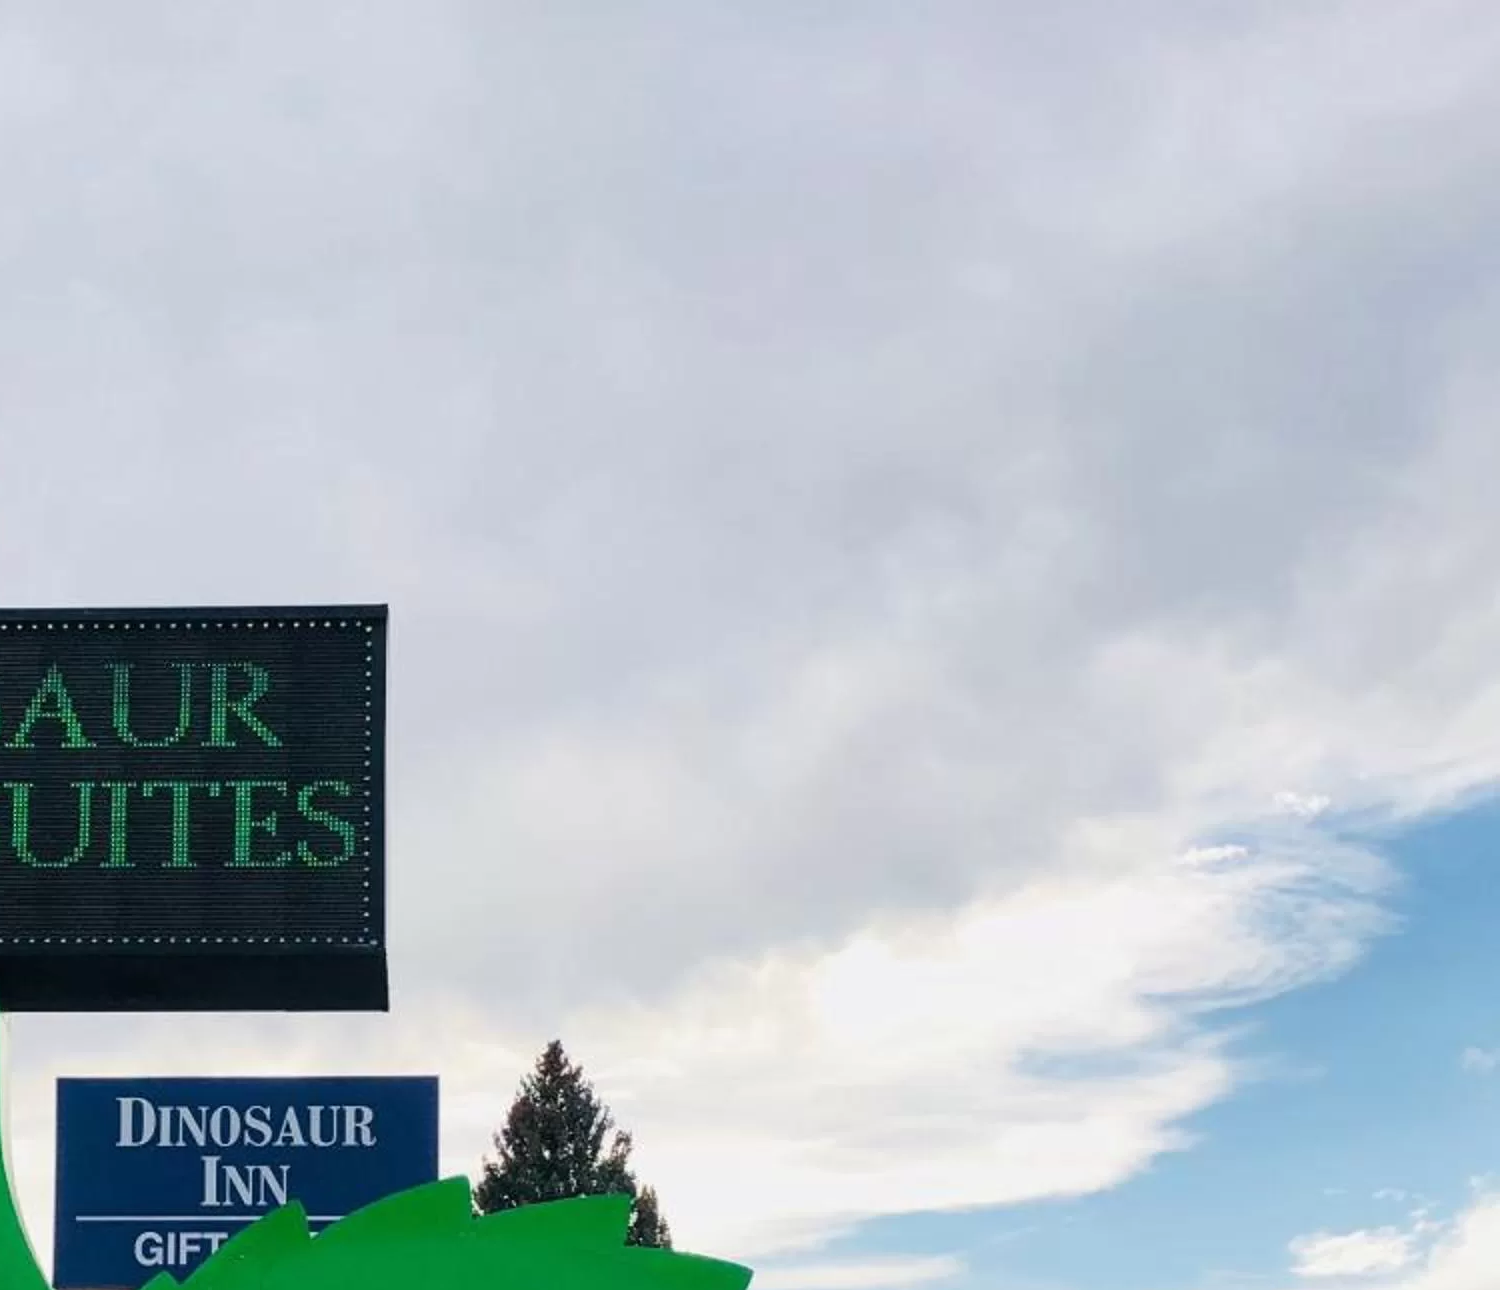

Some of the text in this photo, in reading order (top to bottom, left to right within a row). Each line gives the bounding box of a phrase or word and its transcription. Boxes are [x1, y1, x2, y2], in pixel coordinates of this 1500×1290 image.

[116, 1097, 377, 1147] DINOSAUR
[200, 1155, 291, 1207] INN
[134, 1231, 229, 1267] GIFT
